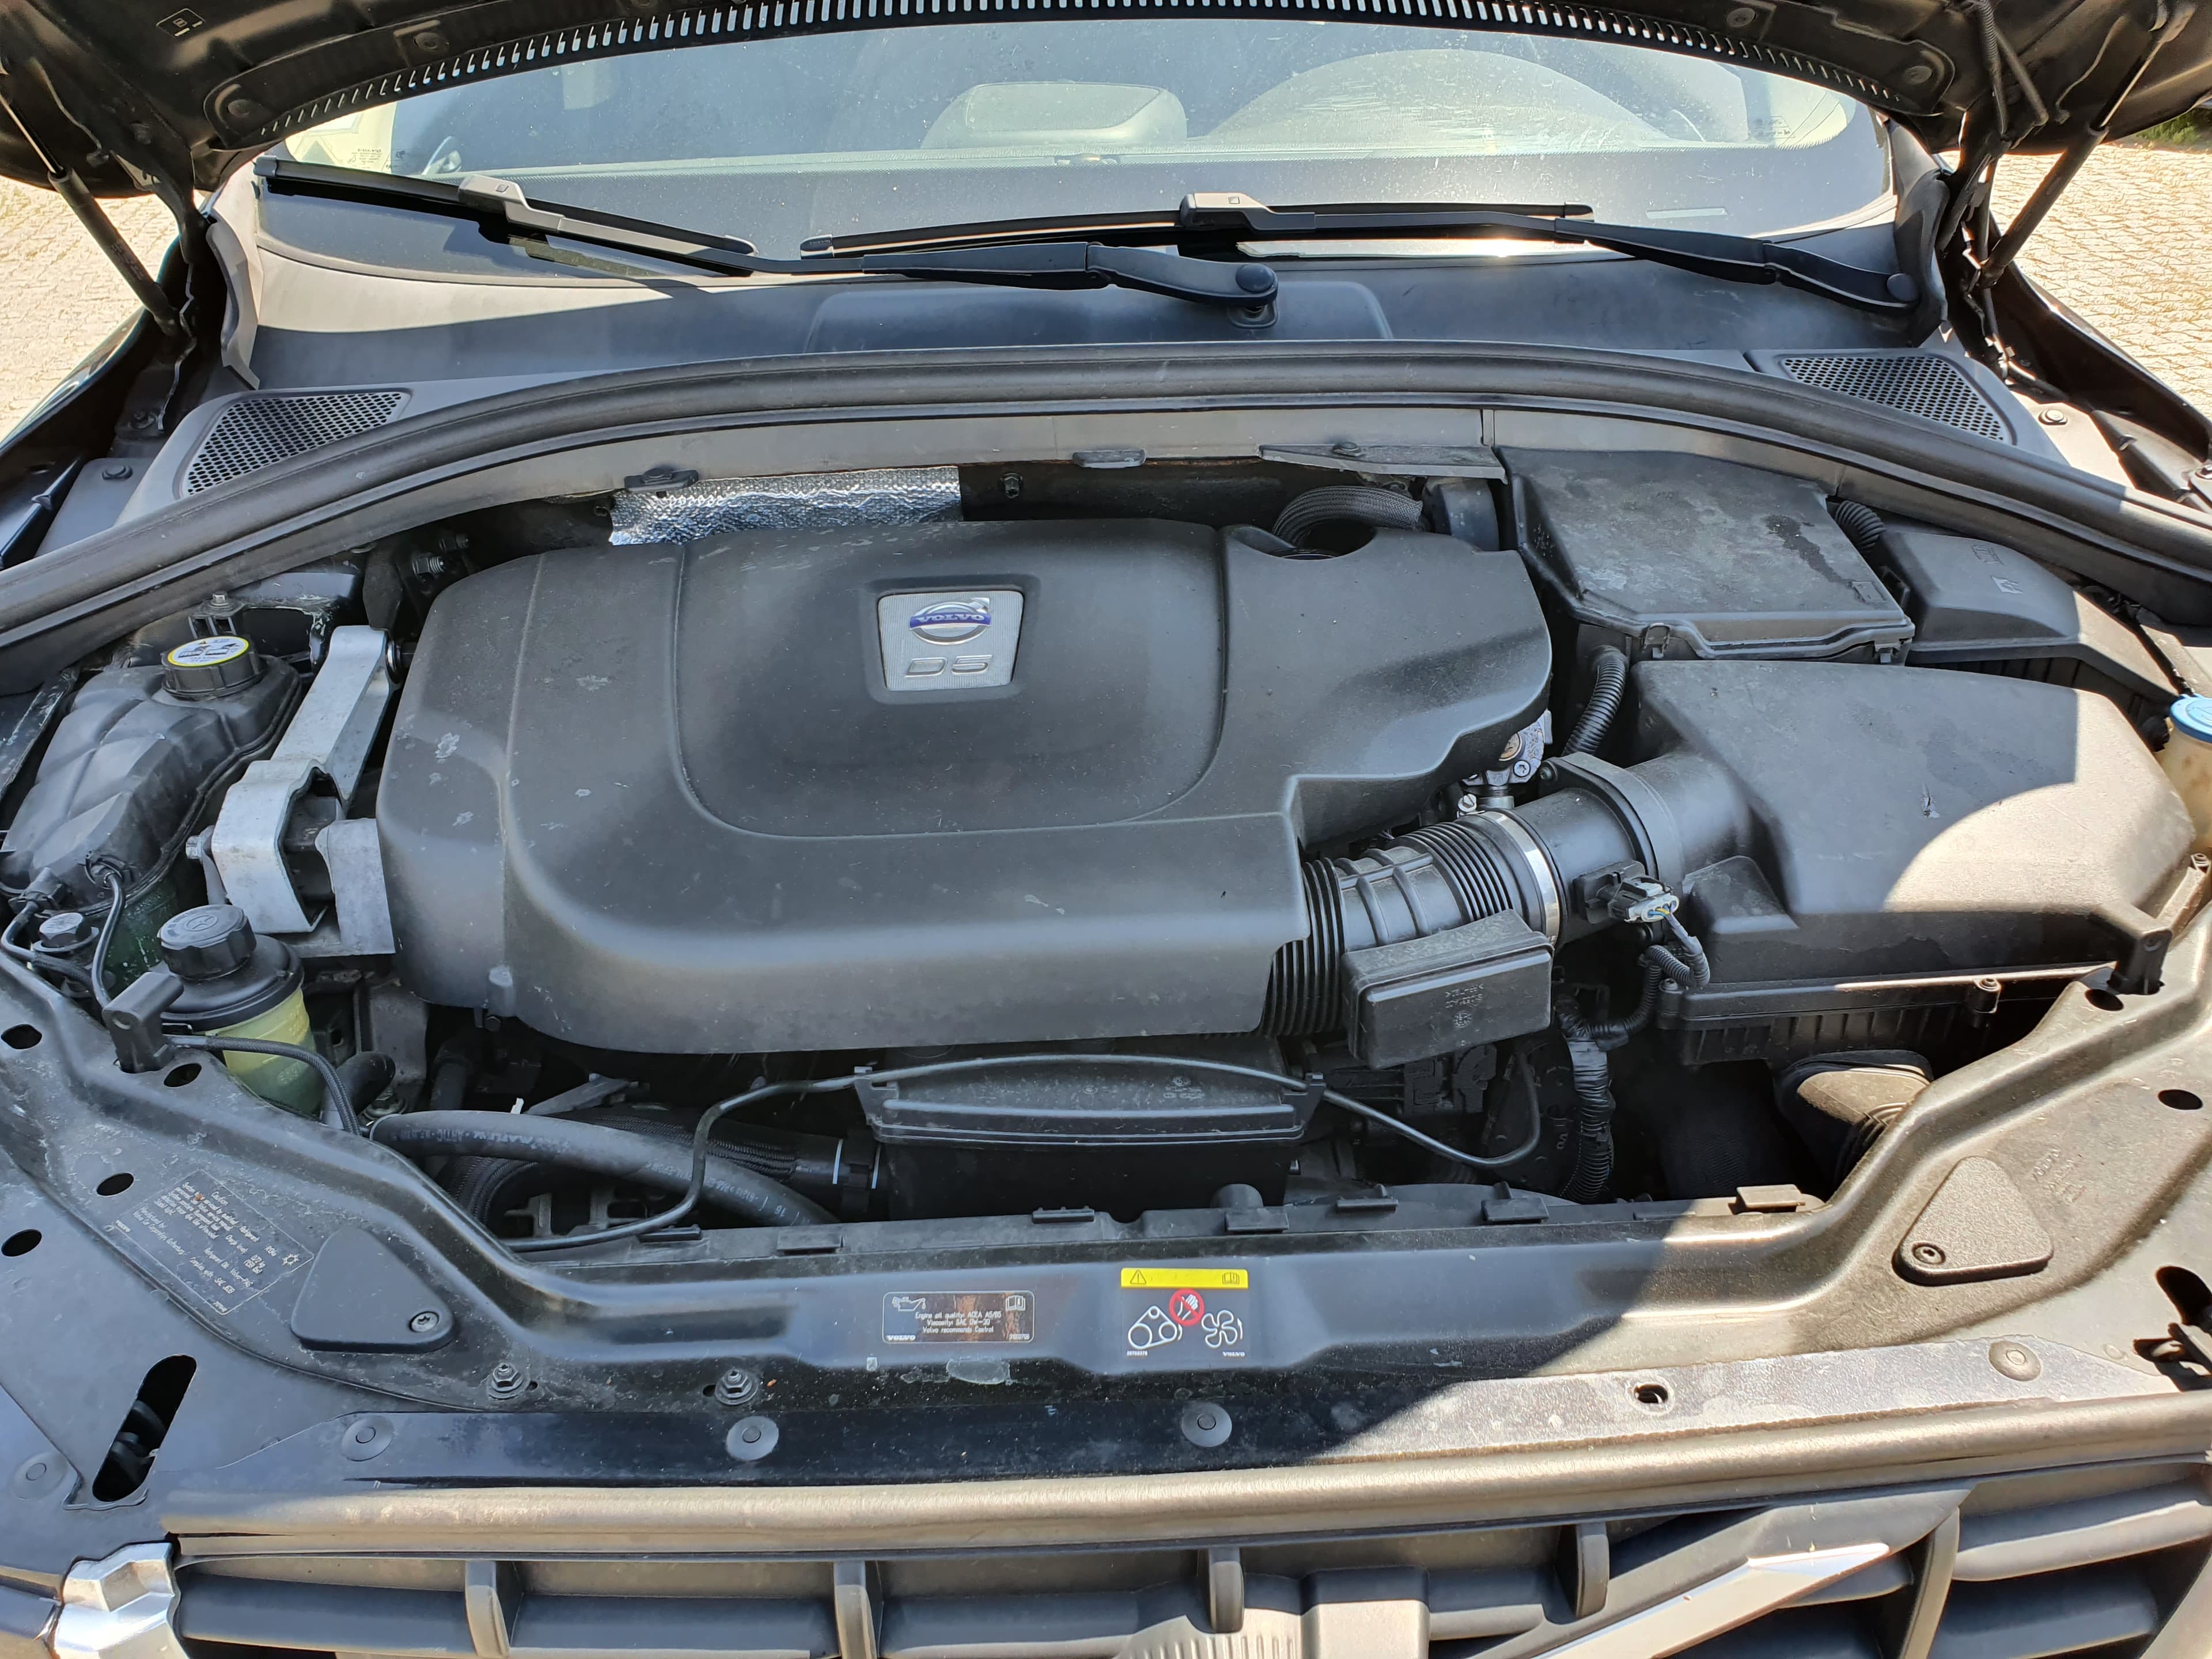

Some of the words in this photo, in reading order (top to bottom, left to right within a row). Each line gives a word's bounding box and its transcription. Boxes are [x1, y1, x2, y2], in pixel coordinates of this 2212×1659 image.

[916, 613, 985, 623] VOLVO
[904, 654, 993, 677] D5
[210, 1191, 232, 1206] Caution
